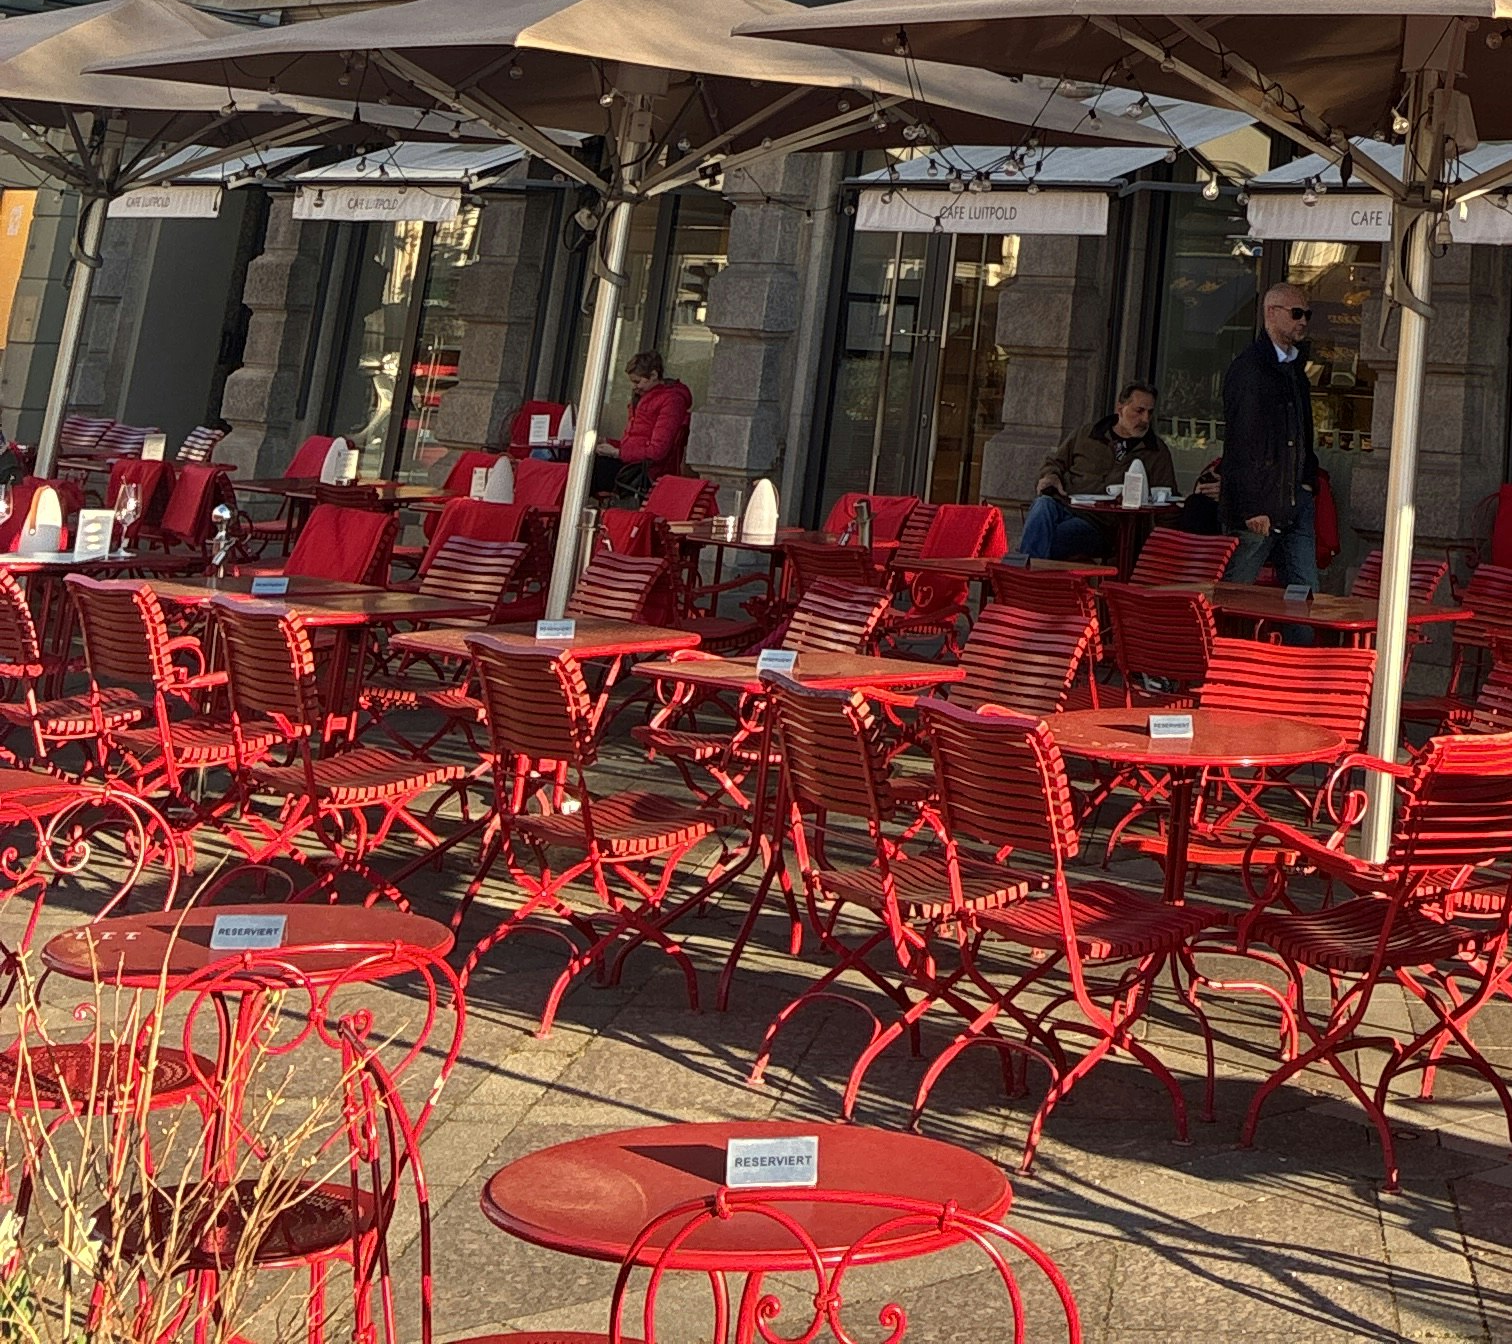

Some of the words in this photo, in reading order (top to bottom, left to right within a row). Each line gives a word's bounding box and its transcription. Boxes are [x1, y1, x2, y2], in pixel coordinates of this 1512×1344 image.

[940, 205, 965, 220] CAFE
[968, 206, 1018, 221] LUITPOLD
[1350, 210, 1383, 226] CAFE
[217, 927, 280, 936] RESERVIERT
[734, 1155, 813, 1168] RESERVIERT
